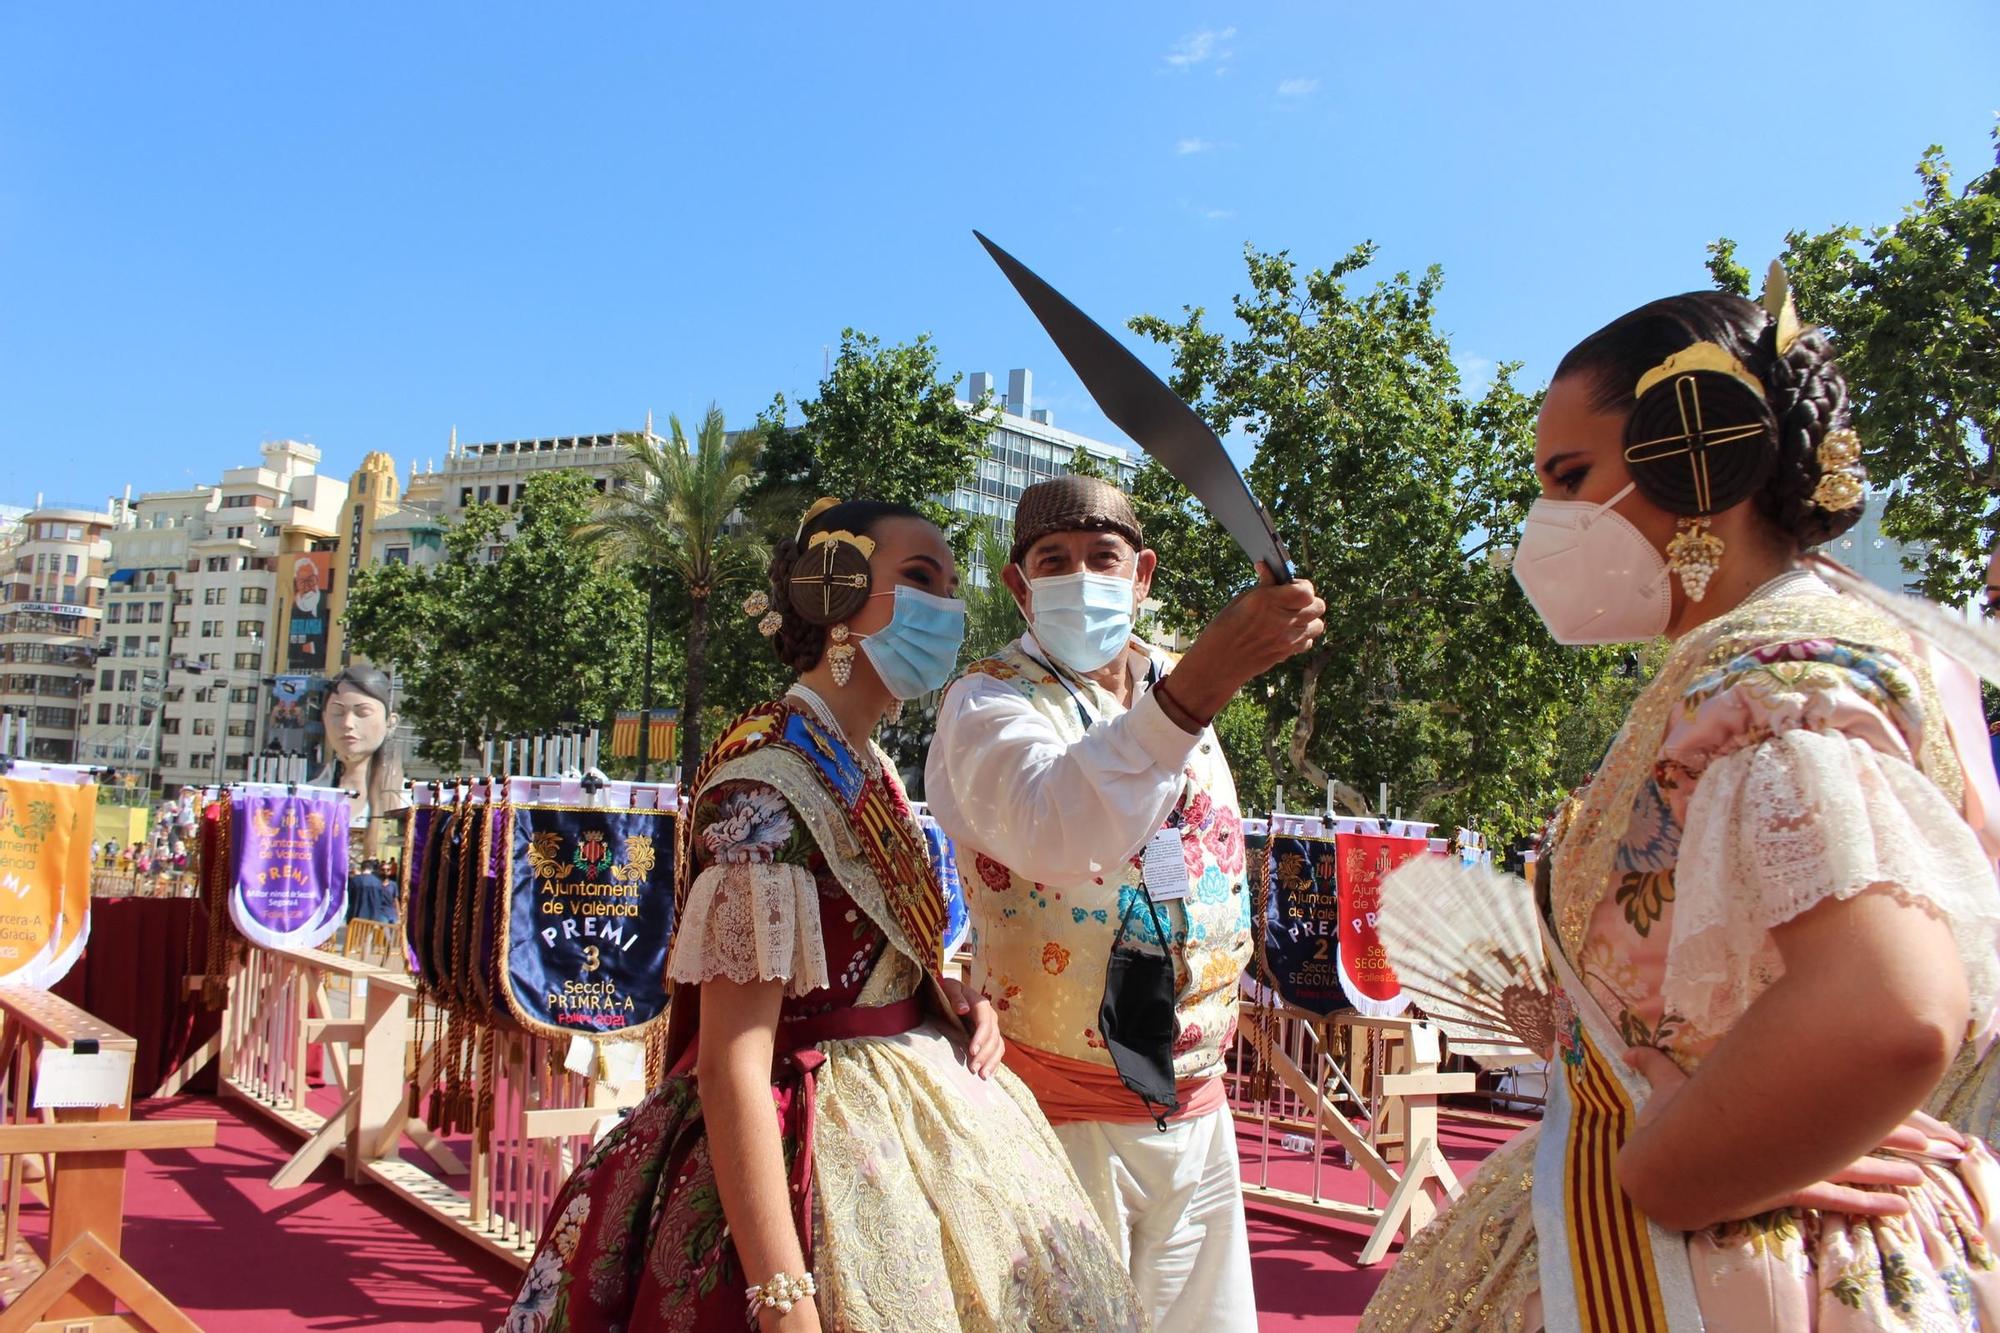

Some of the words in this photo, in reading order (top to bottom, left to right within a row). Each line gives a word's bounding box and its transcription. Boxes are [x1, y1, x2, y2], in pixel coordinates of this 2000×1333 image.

[0, 840, 39, 853] ment
[257, 864, 309, 886] PREMI
[541, 880, 639, 897] Ajuntament
[542, 899, 564, 914] de
[570, 900, 638, 916] València
[1352, 897, 1369, 909] de
[1288, 906, 1304, 918] de
[541, 917, 638, 951] PREMI
[1313, 939, 1328, 959] 2
[582, 945, 600, 971] 3
[564, 979, 615, 994] Secció
